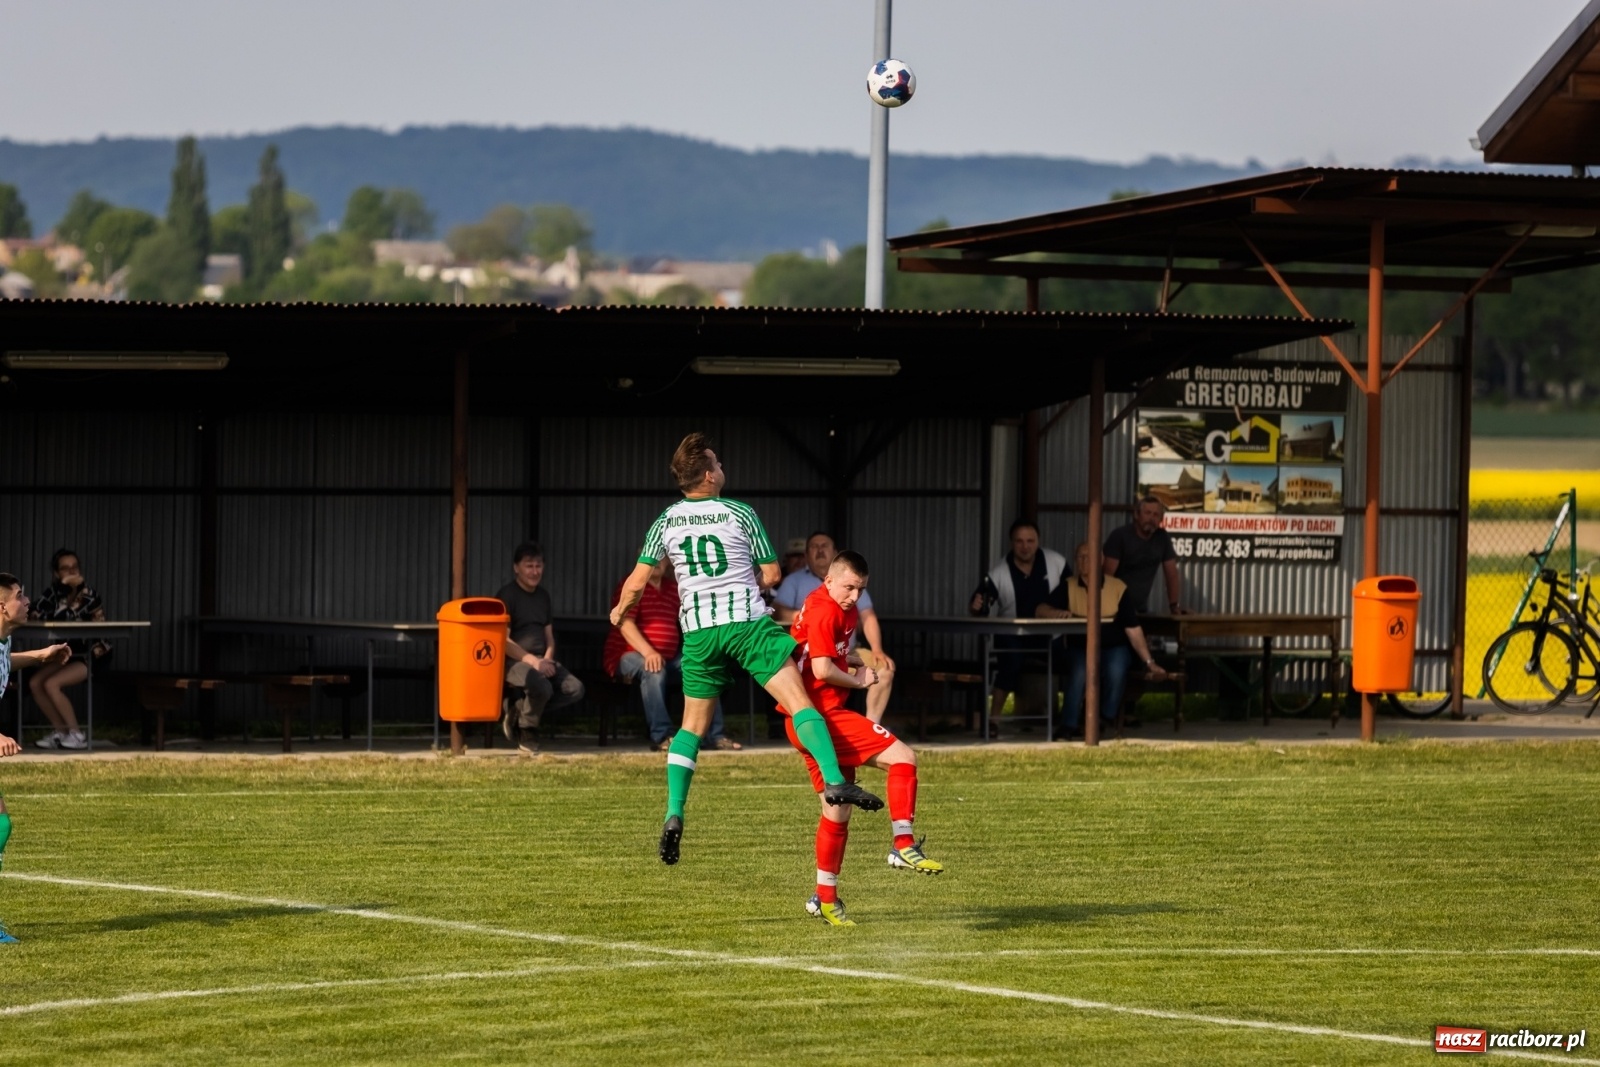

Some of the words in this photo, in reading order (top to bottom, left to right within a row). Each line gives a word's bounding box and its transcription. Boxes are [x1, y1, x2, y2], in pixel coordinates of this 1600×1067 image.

[1195, 364, 1341, 386] Remontowo-Budowlany
[666, 515, 687, 528] RUCH
[1161, 516, 1194, 529] UJEMY
[1197, 517, 1210, 529] OD
[1213, 517, 1288, 531] FUNDAMENTÓW
[1291, 519, 1304, 532] PO
[1307, 519, 1336, 533] DACH!
[678, 534, 729, 577] 10
[1196, 537, 1222, 558] 092
[1224, 538, 1251, 559] 363
[1253, 547, 1334, 561] www.gregorbau.pl
[872, 722, 890, 738] 9
